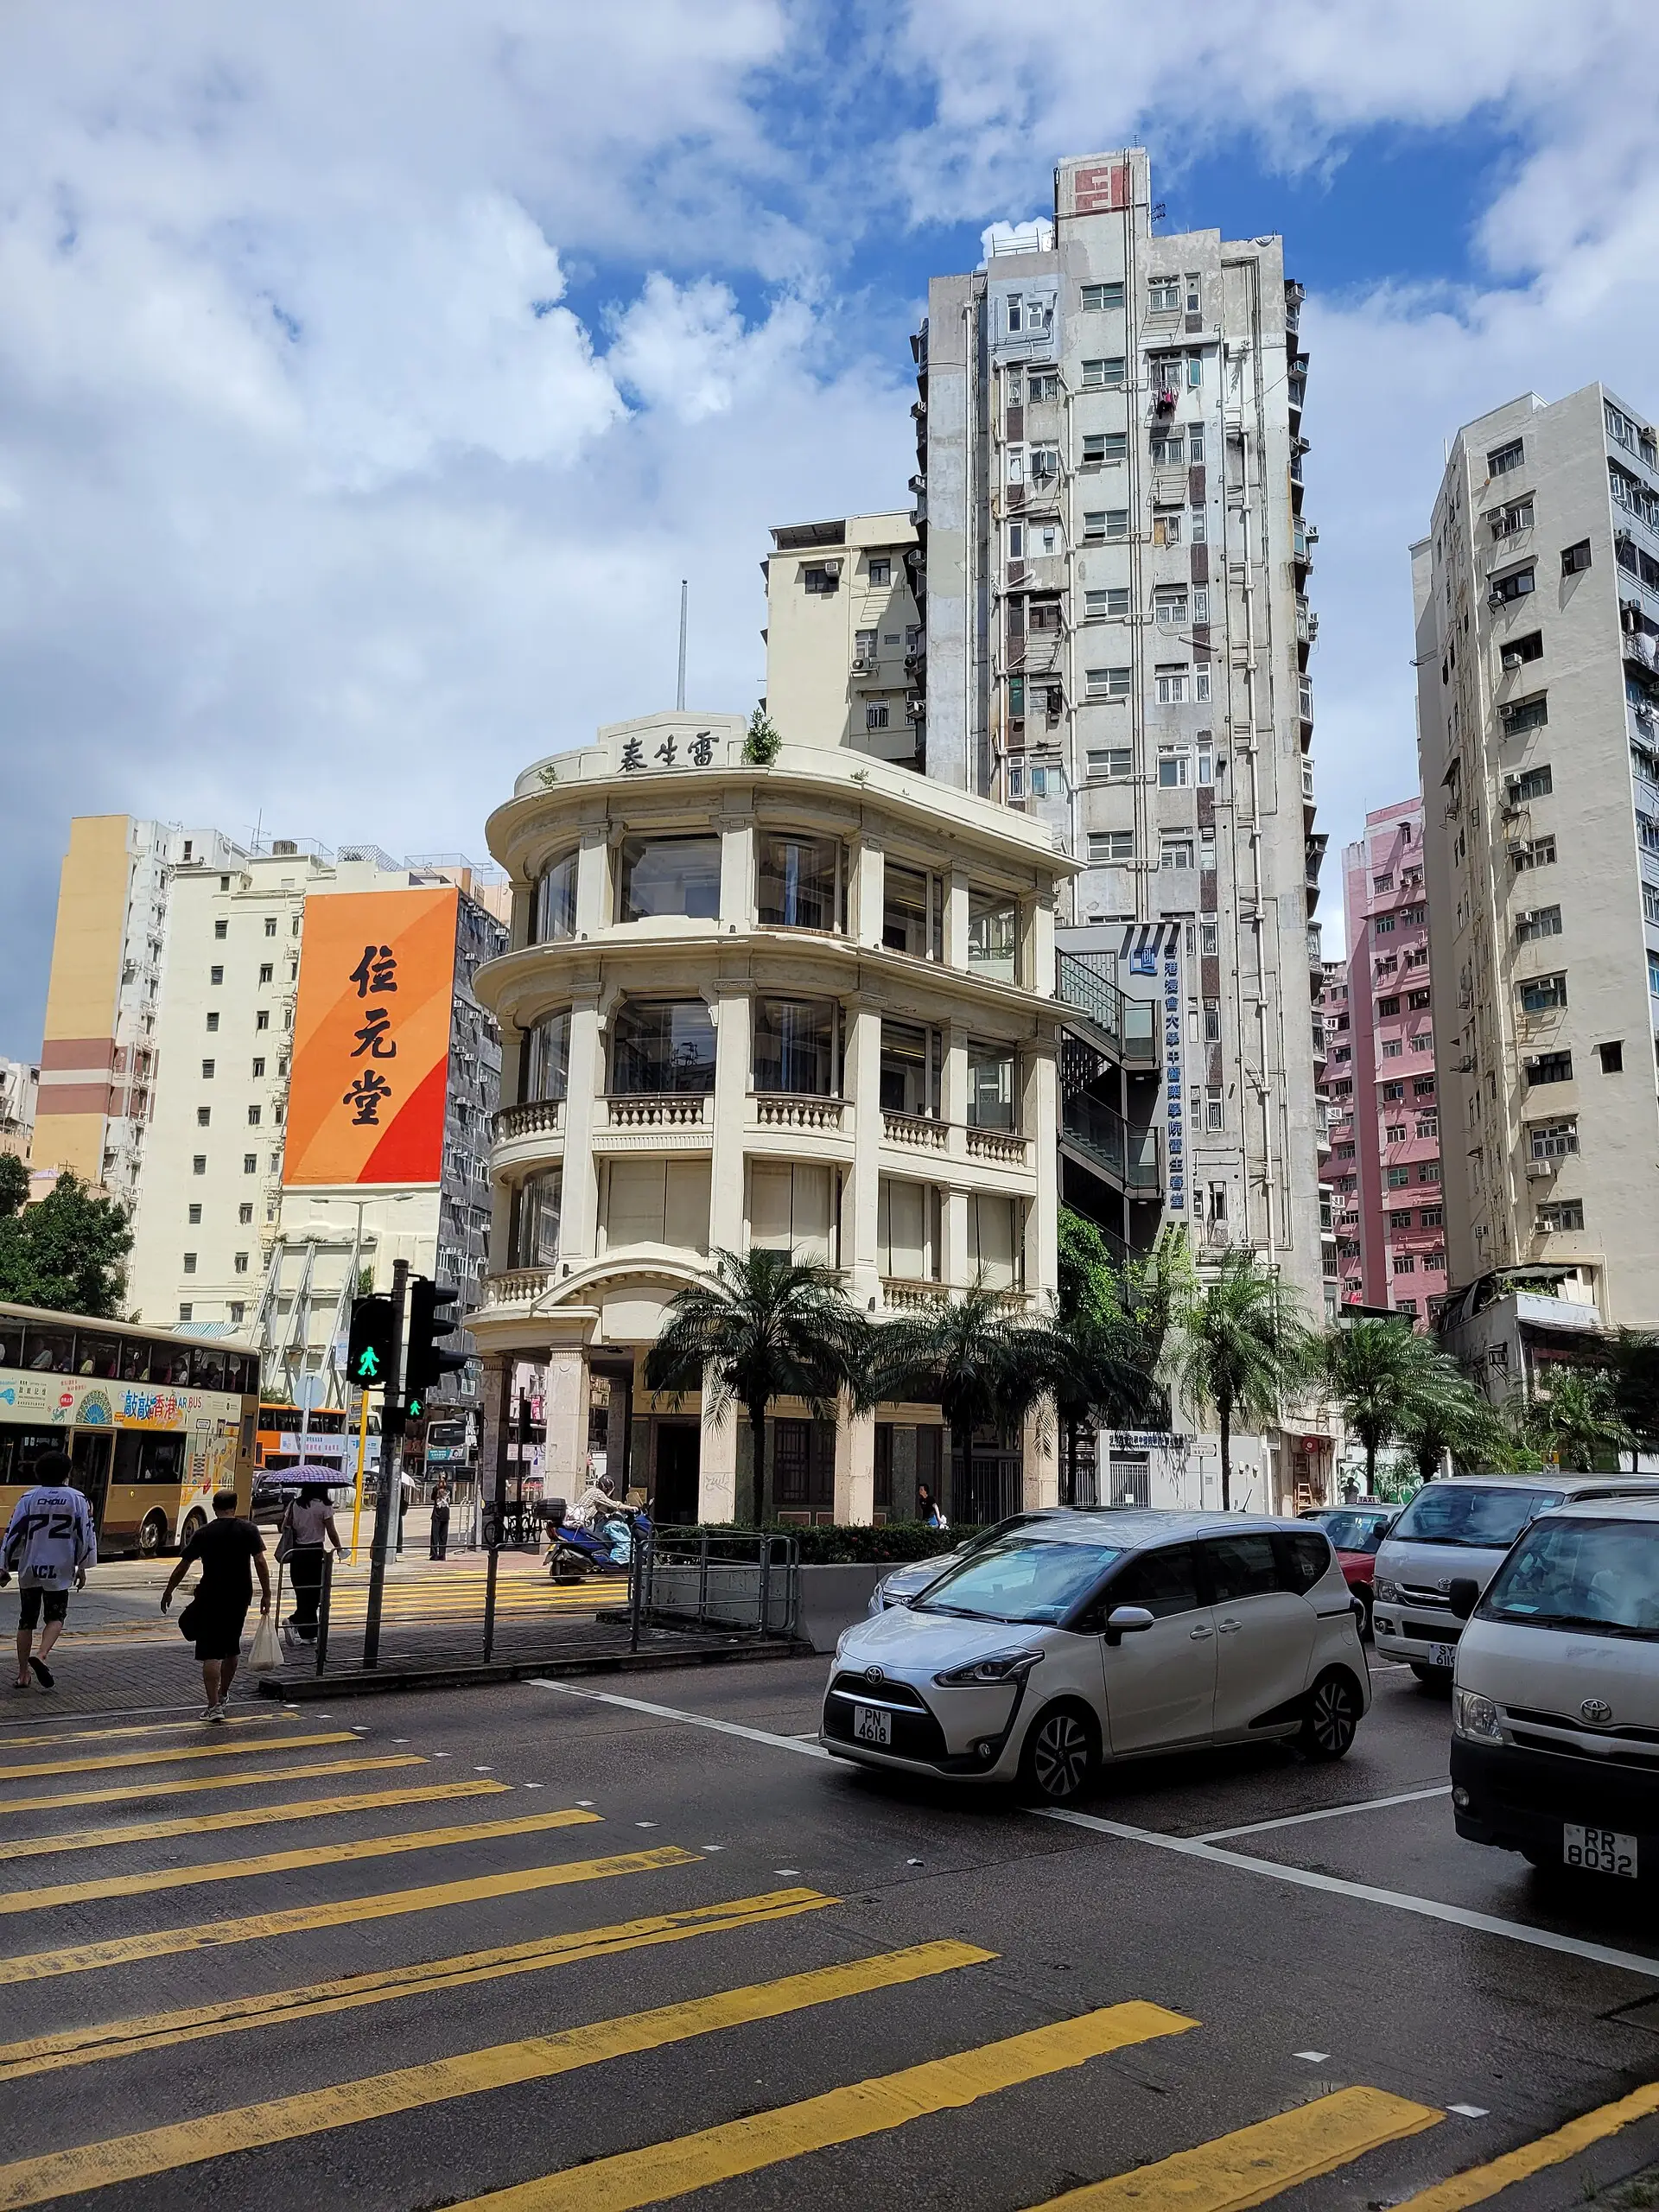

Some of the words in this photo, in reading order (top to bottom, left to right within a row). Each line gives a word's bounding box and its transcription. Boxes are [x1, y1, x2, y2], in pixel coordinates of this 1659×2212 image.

[343, 944, 397, 1126] 位元堂
[178, 1396, 188, 1409] AR
[188, 1396, 202, 1409] BUS
[29, 1513, 73, 1541] 72
[1439, 1644, 1454, 1656] SY
[865, 1708, 881, 1727] PN
[858, 1722, 887, 1743] 4618
[1584, 1827, 1616, 1853] RR
[1567, 1844, 1632, 1877] 8032
